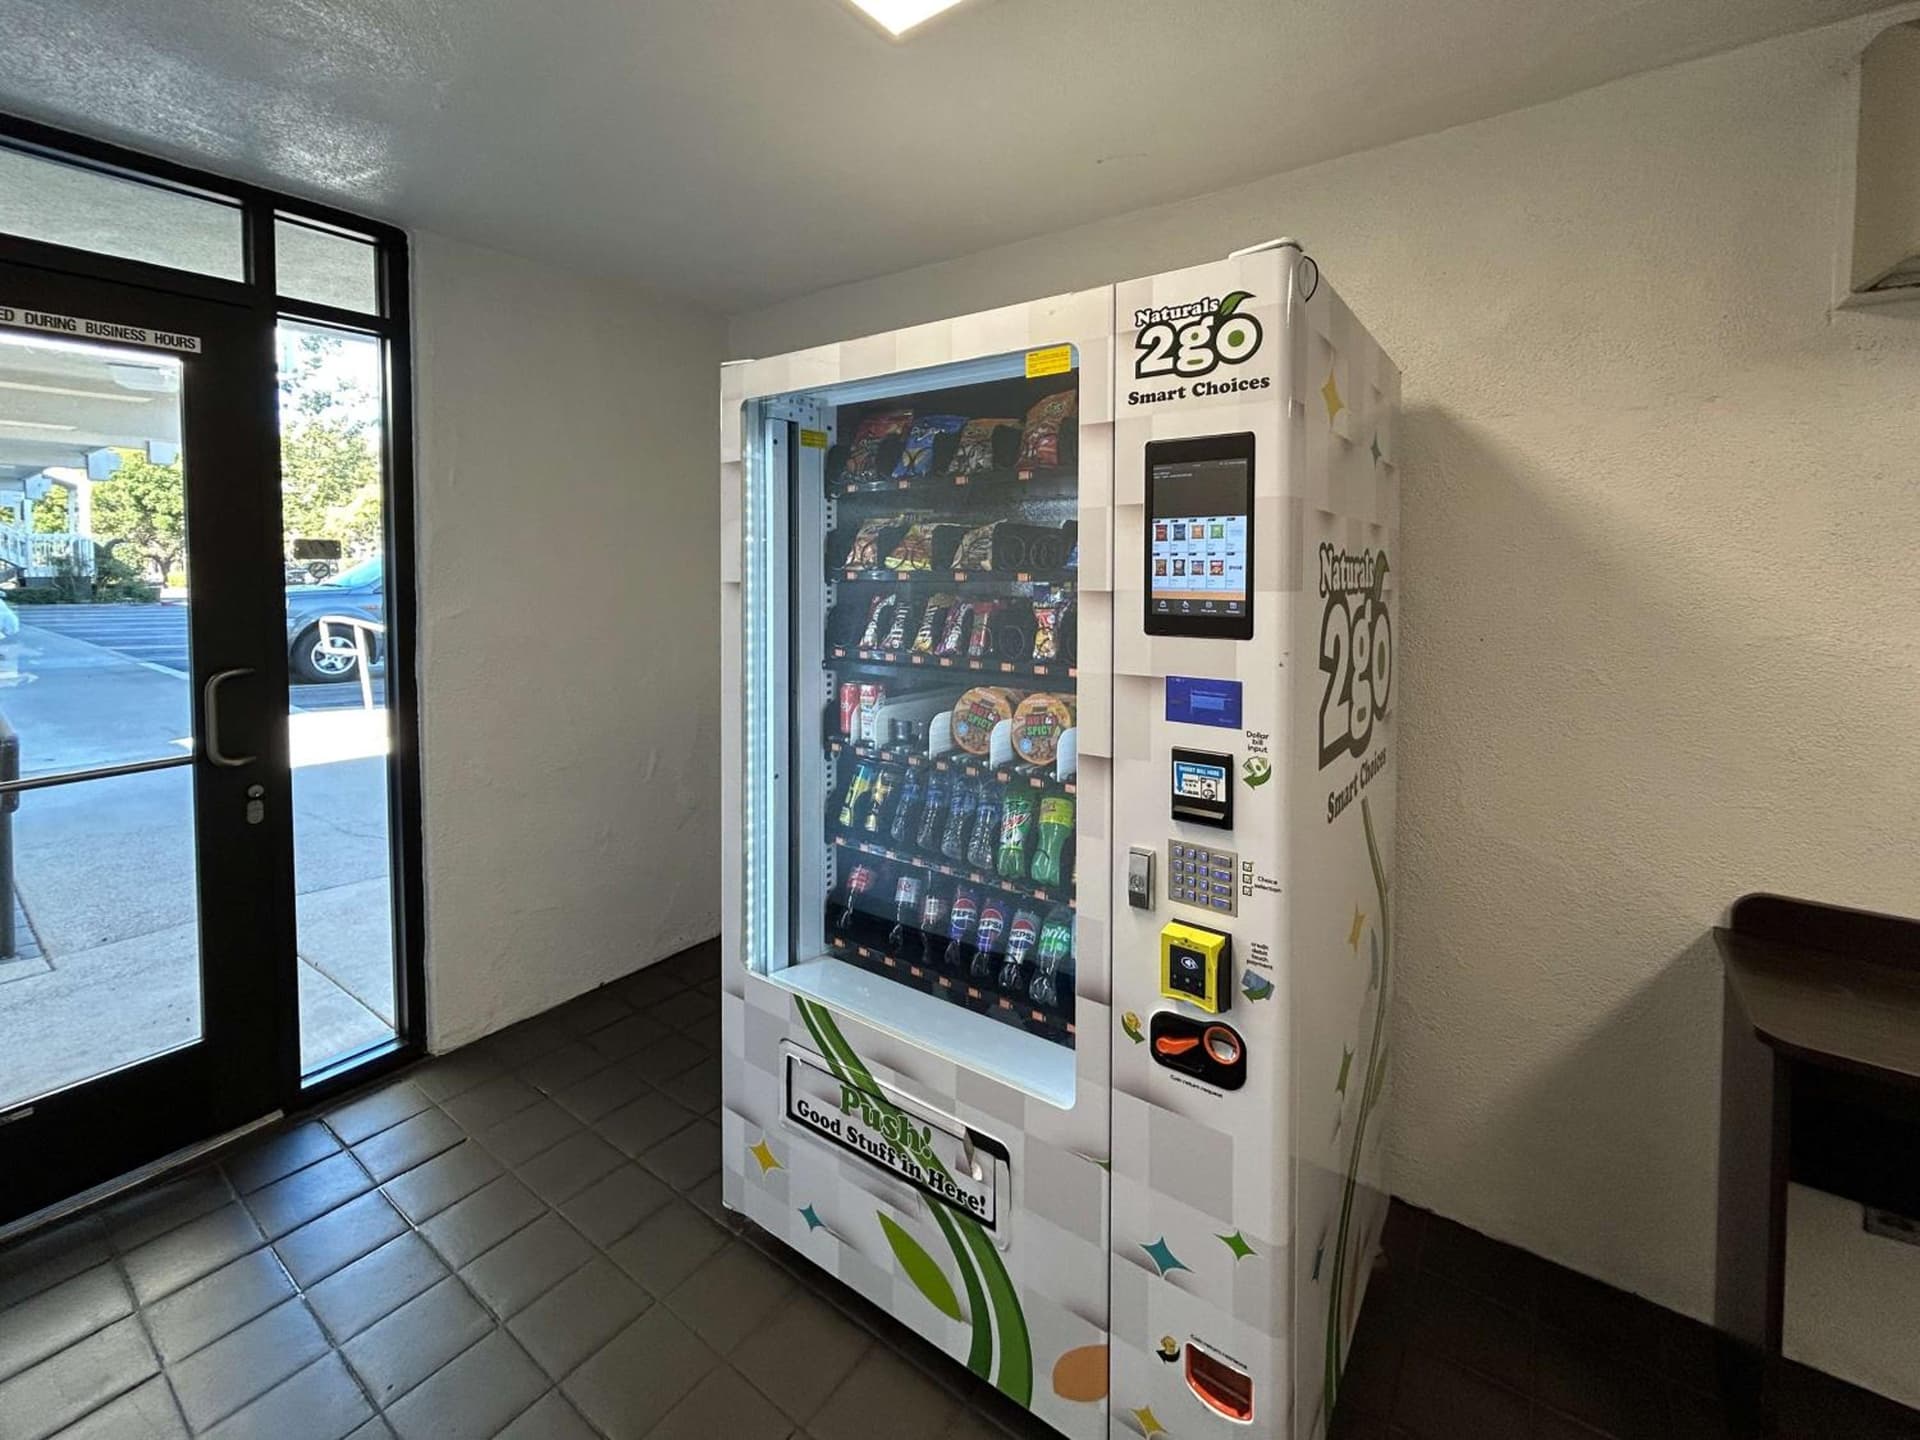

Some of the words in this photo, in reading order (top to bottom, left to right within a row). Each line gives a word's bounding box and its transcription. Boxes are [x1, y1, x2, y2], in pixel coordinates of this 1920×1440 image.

[25, 311, 77, 331] DURING
[85, 322, 147, 342] BUSINESS
[154, 333, 196, 349] HOURS
[1135, 297, 1220, 327] Naturals
[1128, 386, 1186, 405] Smart
[1192, 377, 1270, 397] Choices
[1319, 542, 1374, 598] Naturals
[1246, 730, 1269, 740] Dollar
[1327, 772, 1359, 824] Smart
[1359, 748, 1387, 791] Choices
[1041, 924, 1071, 942] prite
[839, 1084, 932, 1159] Push!
[797, 1099, 841, 1136] Good
[846, 1125, 897, 1167] Stuff
[900, 1154, 922, 1180] in
[928, 1166, 986, 1216] Here!
